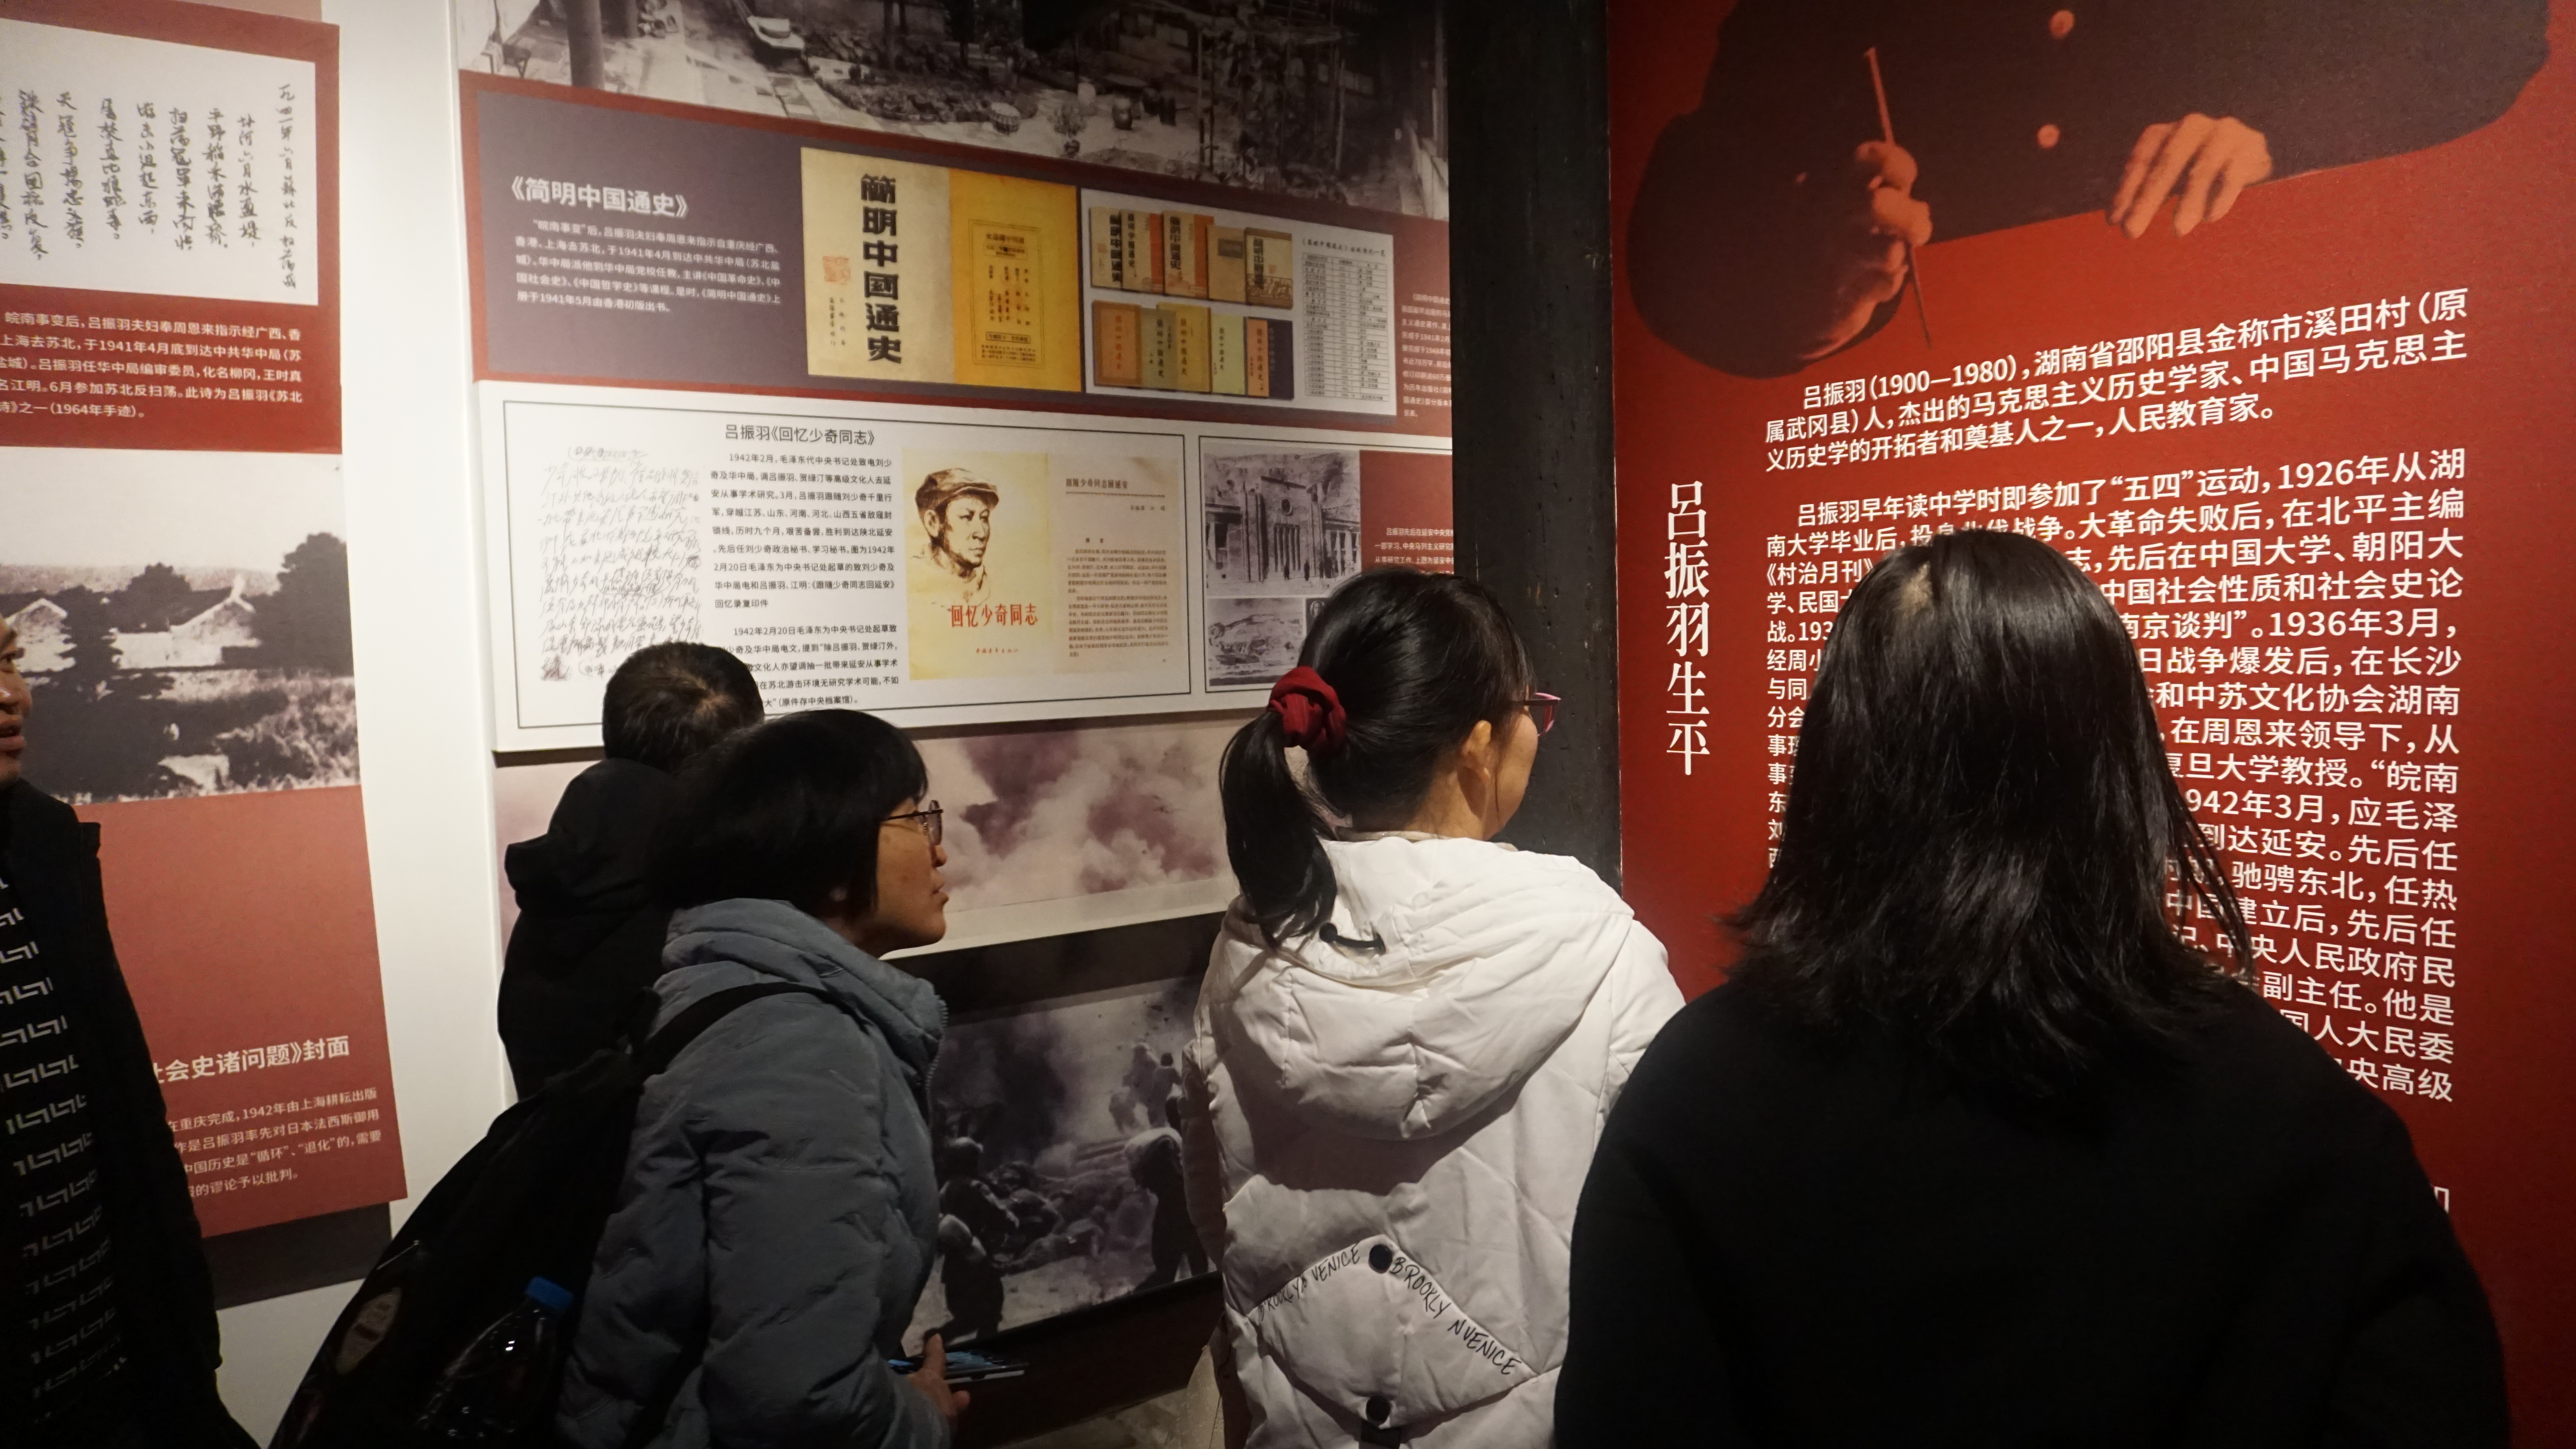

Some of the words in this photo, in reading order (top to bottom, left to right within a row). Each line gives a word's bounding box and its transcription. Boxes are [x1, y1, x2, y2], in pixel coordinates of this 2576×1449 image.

[512, 176, 688, 218] 《简明中国通史》
[861, 174, 902, 364] 簡明中國通史
[4, 312, 300, 341] 皖南事变后，吕振羽夫妇奉周恩来指示经广西、香
[1803, 288, 2468, 410] 吕振羽（1900—1980），湖南省邵阳县金称市溪田村（原
[1766, 330, 2467, 444] 属武冈县）人，杰出的马克思主义历史学家、中国马克思主
[725, 424, 875, 447] 吕振羽《回忆少奇同志》
[1766, 393, 2273, 473] 义历史学的开拓者和奠基人之一，人民教育家。
[1798, 448, 2465, 527] 吕振羽早年读中学时即参加了“五四”运动，1926年从湖
[715, 598, 769, 609] 回忆录复印件
[2103, 567, 2464, 606] 中国社会性质和社会史论
[734, 624, 897, 637] 1942年2月20日毛泽东为中央书记处起草致
[950, 603, 1038, 628] 回忆少奇同志
[1664, 481, 1710, 776] 吕振羽生平
[718, 642, 897, 654] 少奇及华中局电文，提到“除吕振羽、贺绿汀外，
[2148, 682, 2460, 716] 和中苏文化协会湖南
[1311, 1243, 1360, 1282] VENICE
